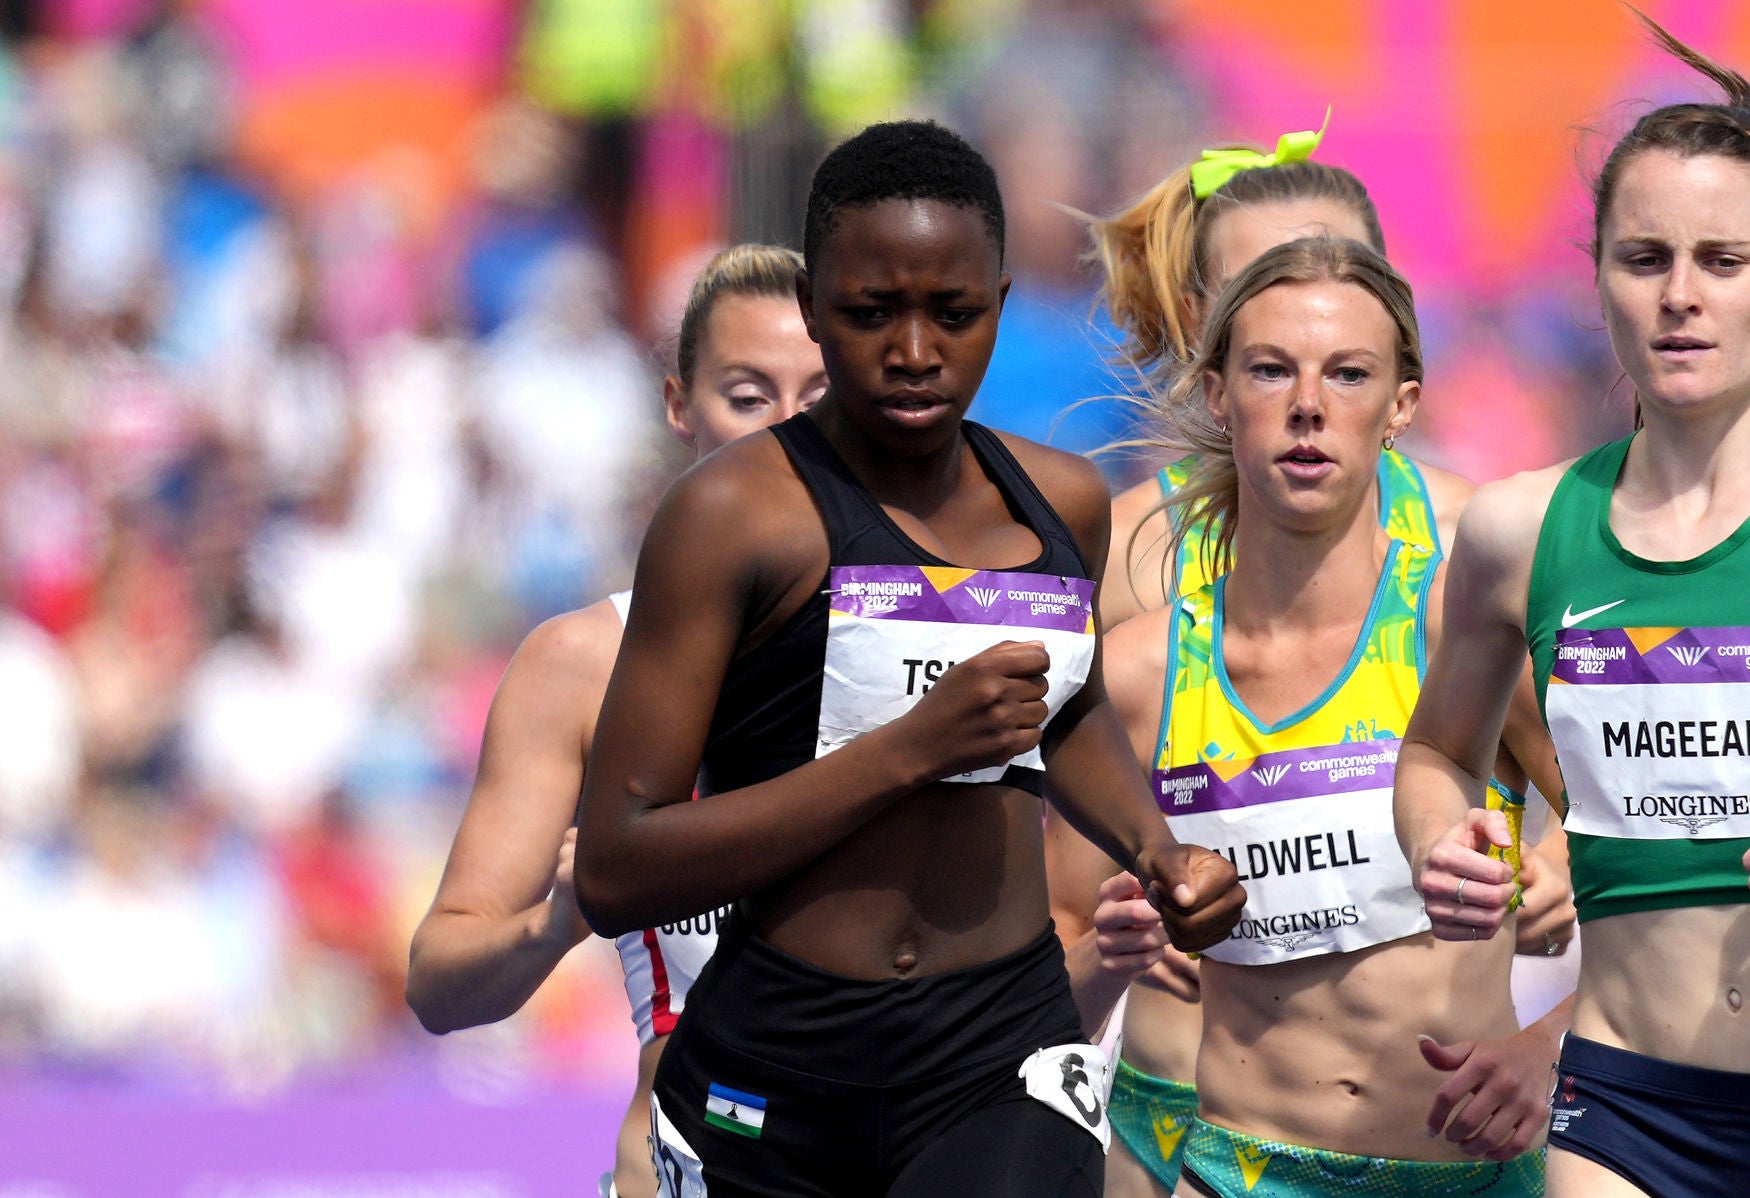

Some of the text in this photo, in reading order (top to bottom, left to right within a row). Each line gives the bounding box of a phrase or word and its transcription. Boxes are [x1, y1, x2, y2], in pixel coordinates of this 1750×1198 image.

[841, 582, 922, 596] BIRMINGHAM
[865, 595, 898, 609] 2022
[1030, 602, 1067, 615] games
[1558, 646, 1626, 661] BIRMINGHAM
[1576, 660, 1605, 674] 2022
[1329, 764, 1376, 782] games
[1161, 775, 1209, 795] BIRMINGHAM
[1174, 790, 1193, 805] 2022
[1213, 829, 1371, 882] LDWELL
